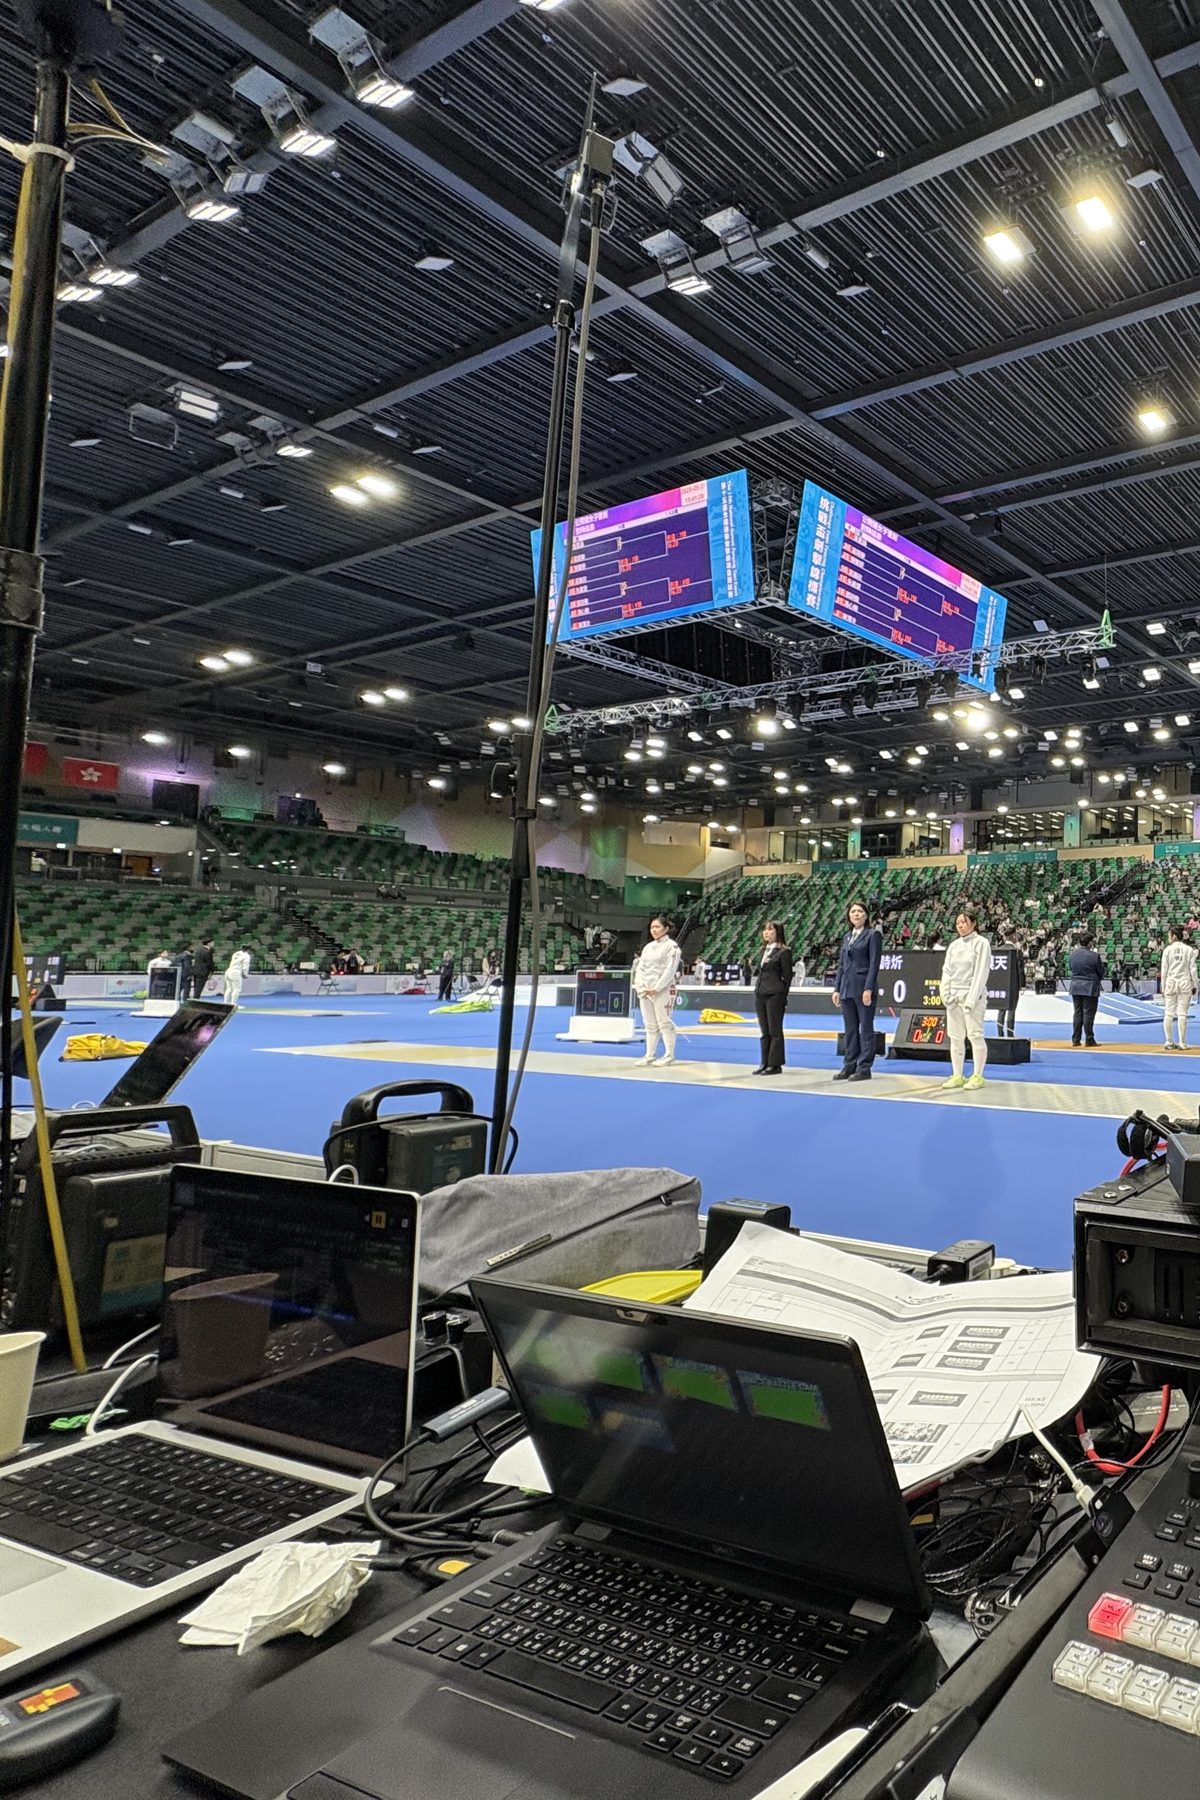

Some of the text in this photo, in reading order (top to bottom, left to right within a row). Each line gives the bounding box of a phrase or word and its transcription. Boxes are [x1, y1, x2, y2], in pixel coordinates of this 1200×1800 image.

[893, 980, 907, 1003] 0
[912, 1029, 922, 1044] 0
[935, 1030, 944, 1044] 0
